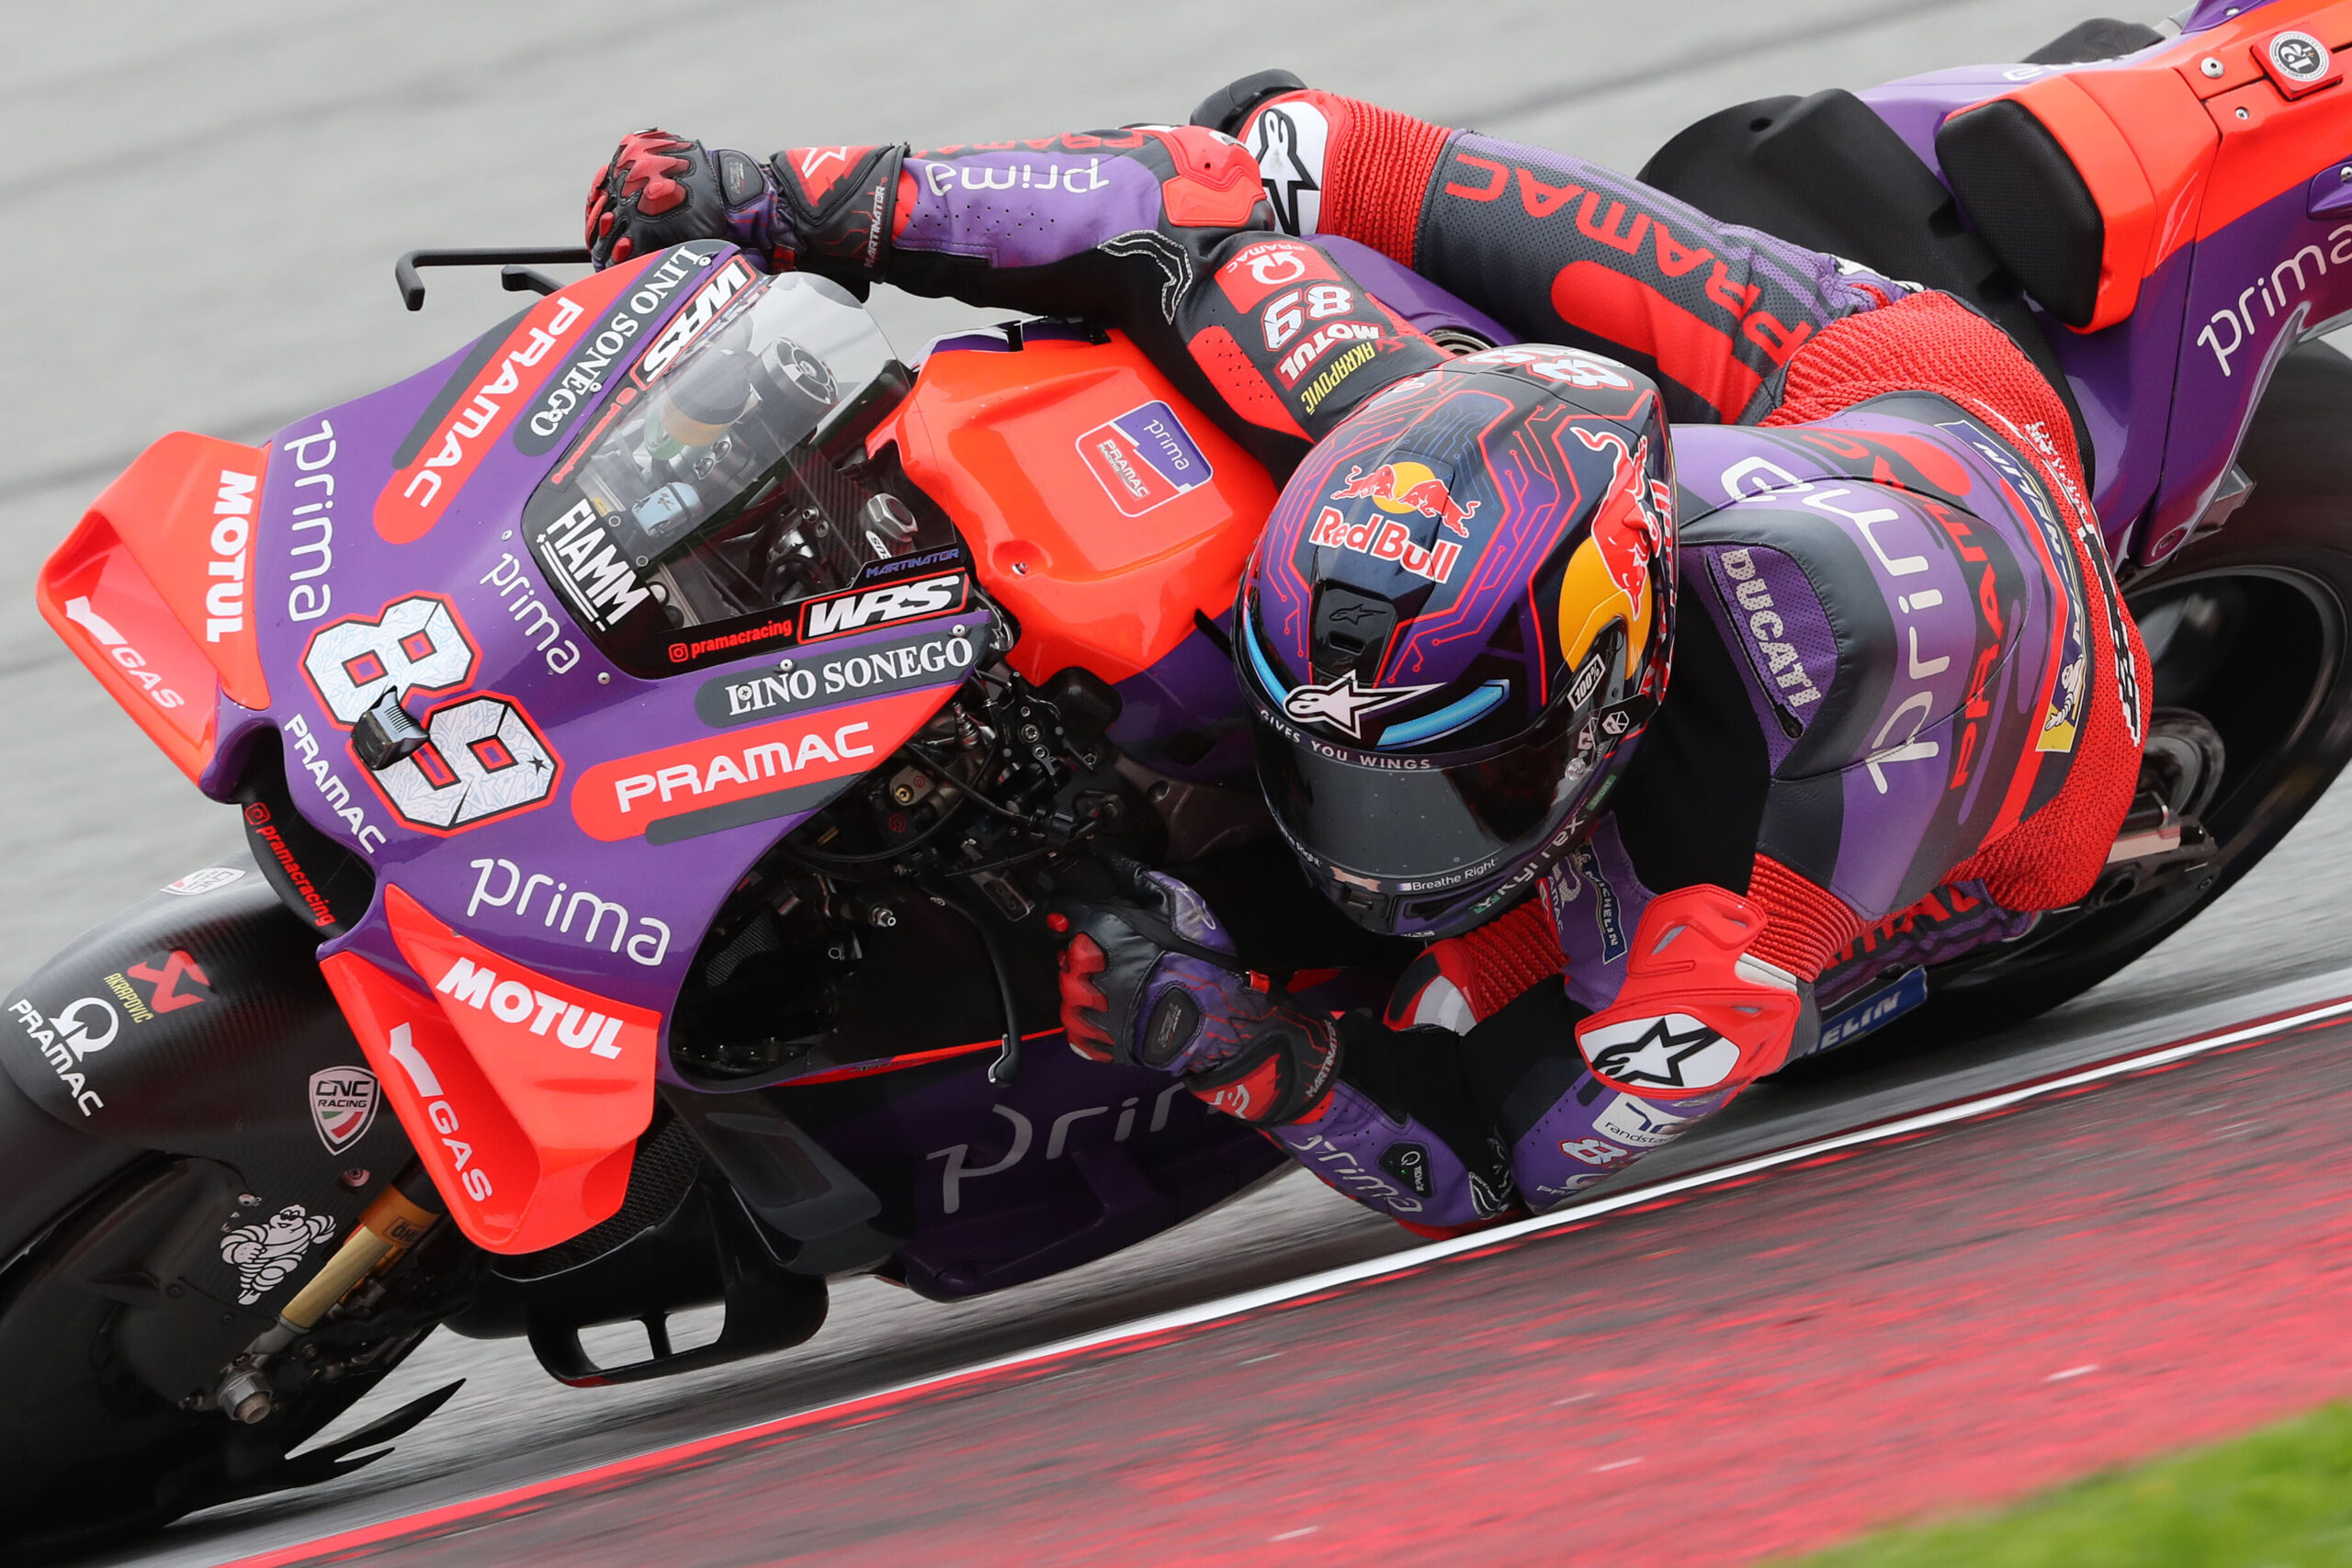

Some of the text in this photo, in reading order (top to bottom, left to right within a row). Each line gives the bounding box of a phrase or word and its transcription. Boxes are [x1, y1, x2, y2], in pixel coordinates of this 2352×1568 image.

[925, 158, 1110, 197] prima
[628, 244, 702, 316] LINO
[1227, 243, 1306, 274] PRAMAC
[1445, 153, 1813, 367] PRAMAC
[641, 262, 748, 382] WRS
[1261, 285, 1353, 352] 89
[1280, 322, 1380, 381] MOTUL
[404, 297, 584, 507] PRAMAC
[531, 309, 641, 437] SONEGO
[1102, 438, 1151, 498] PRAMAC
[1143, 419, 1190, 470] prima
[207, 469, 257, 643] MOTUL
[284, 420, 336, 622] prima
[1308, 505, 1463, 585] Red Bull
[547, 499, 649, 625] FIAMM
[865, 547, 959, 579] MARTINATOR
[480, 552, 581, 674] prima
[691, 620, 793, 658] pramacracing
[808, 574, 960, 637] WRS
[1720, 548, 1822, 708] DUCATI
[1721, 456, 1950, 794] prima
[110, 646, 186, 708] GAS
[301, 593, 561, 832] 89
[727, 637, 974, 716] LINO SONEGO
[1574, 662, 1600, 704] 100%
[614, 721, 875, 813] PRAMAC
[1260, 709, 1430, 770] GIVES YOU WINGS
[284, 714, 387, 855] PRAMAC
[256, 822, 336, 928] pramacracing
[467, 859, 672, 966] prima
[1412, 858, 1496, 891] Breathe Right
[1585, 871, 1619, 946] MICHELIN
[436, 957, 624, 1059] MOTUL
[1818, 990, 1902, 1050] ELIN
[8, 998, 104, 1117] PRAMAC
[315, 1080, 372, 1097] CNC
[317, 1099, 368, 1109] RACING
[1605, 1122, 1674, 1145] randsta
[428, 1100, 492, 1203] GAS
